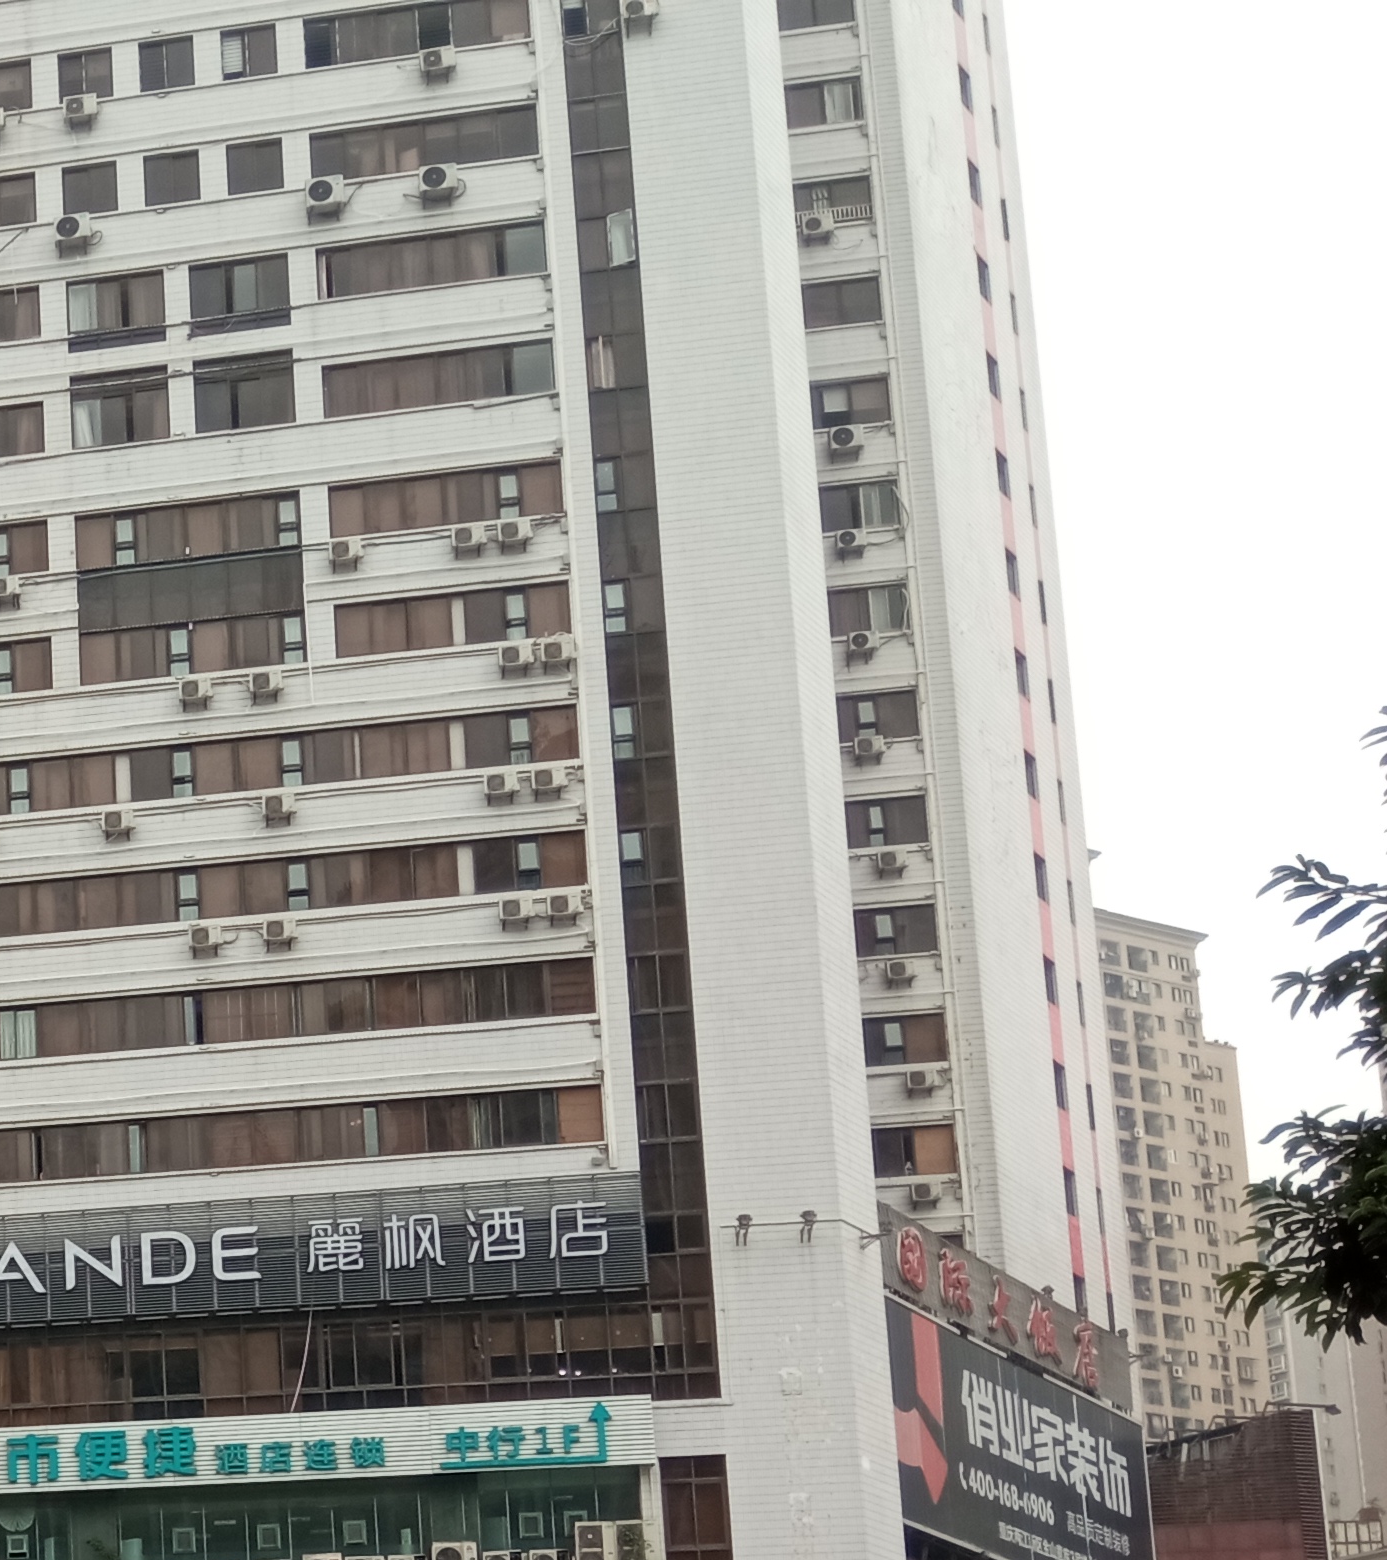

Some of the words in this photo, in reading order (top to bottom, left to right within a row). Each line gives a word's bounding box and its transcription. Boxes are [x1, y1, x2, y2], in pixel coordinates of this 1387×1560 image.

[214, 1437, 385, 1475] 酒店连锁
[961, 1369, 1132, 1518] 俏业家装饰
